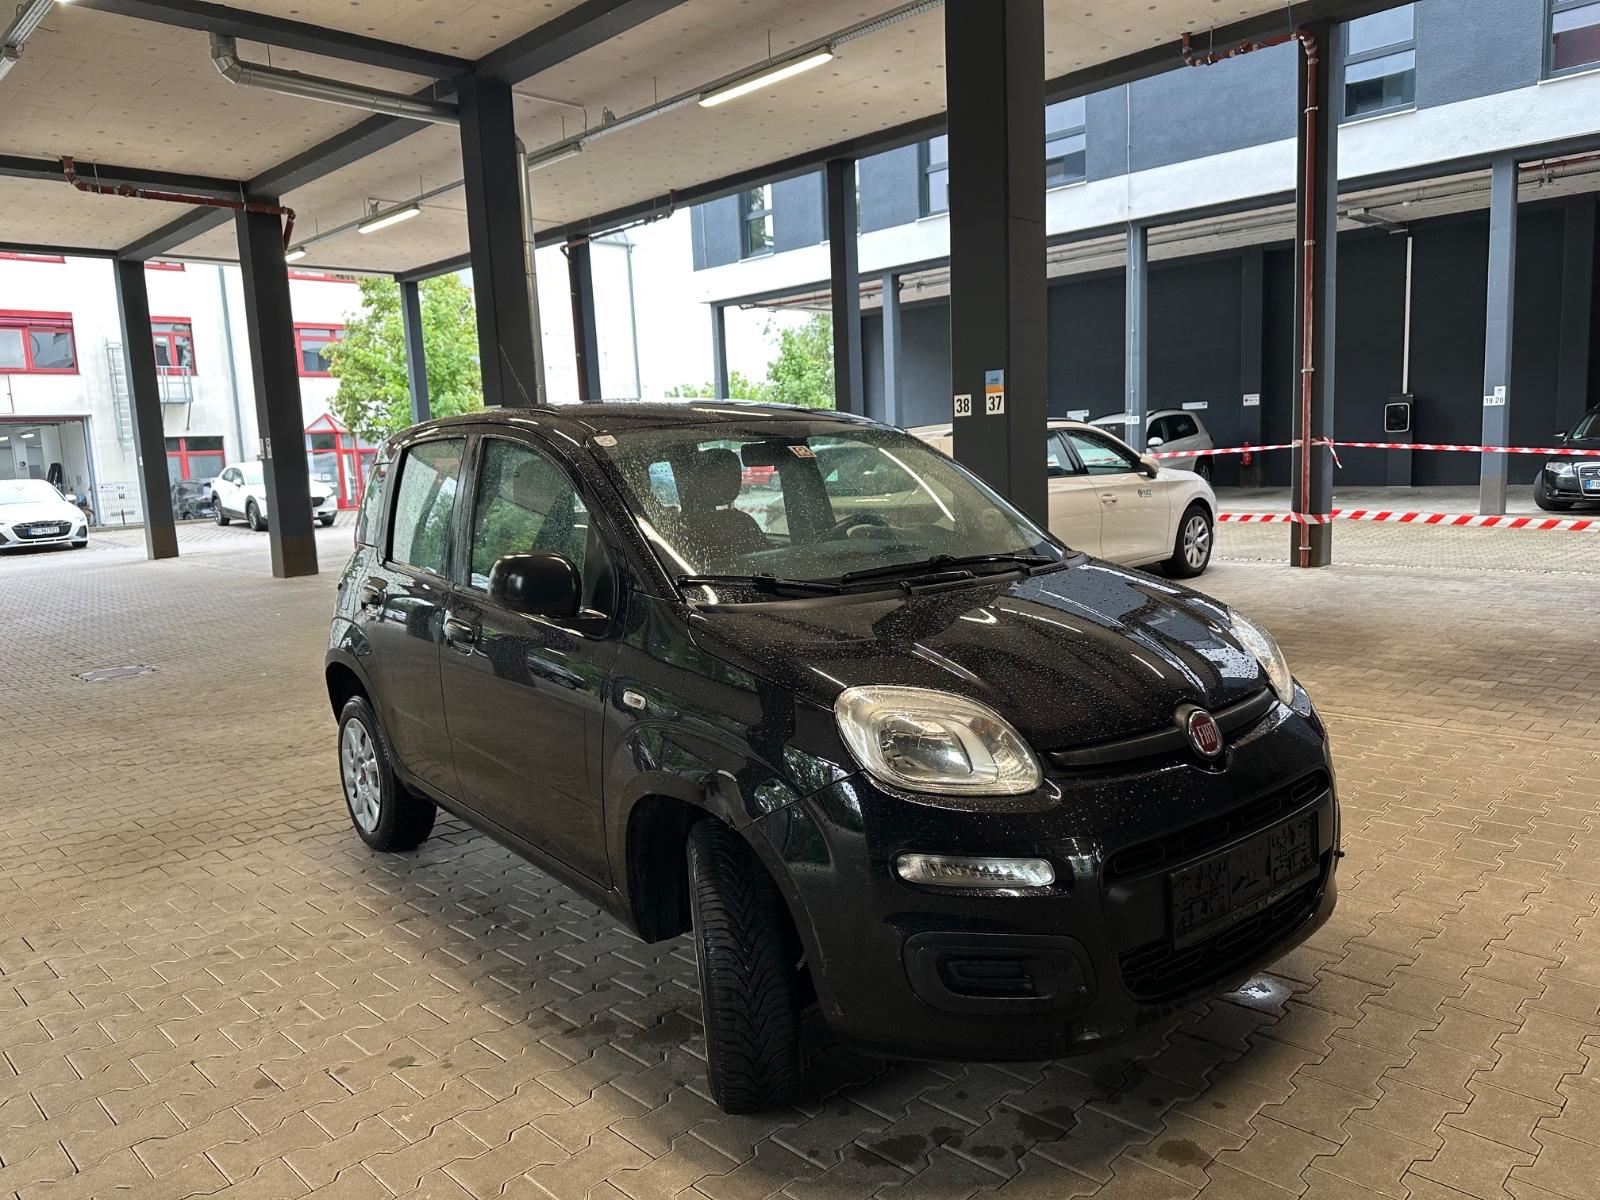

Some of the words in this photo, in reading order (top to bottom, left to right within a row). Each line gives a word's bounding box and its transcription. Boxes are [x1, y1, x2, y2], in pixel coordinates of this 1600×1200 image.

[956, 397, 970, 413] 38
[988, 395, 1002, 411] 37
[1195, 722, 1217, 746] FIAT
